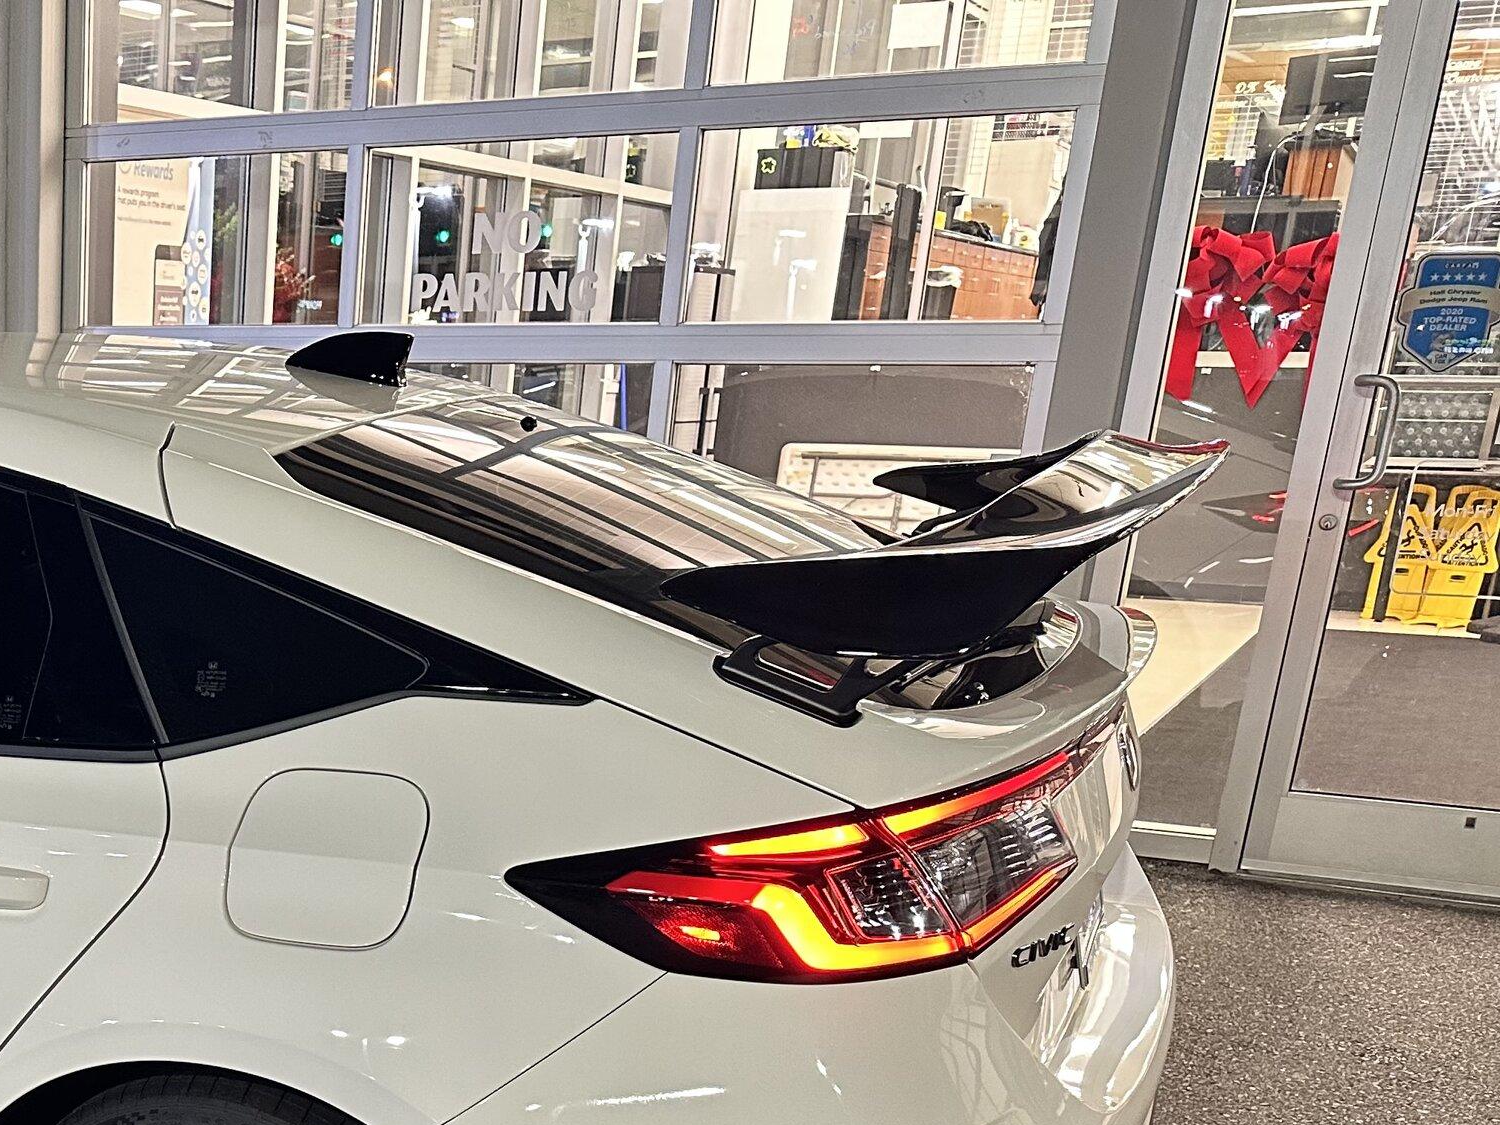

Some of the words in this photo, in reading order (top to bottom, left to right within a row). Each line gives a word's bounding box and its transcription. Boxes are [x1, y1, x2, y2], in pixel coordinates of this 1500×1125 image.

[133, 162, 174, 180] Rewards
[471, 211, 542, 254] NO
[411, 271, 599, 313] PARKING
[1423, 316, 1477, 325] TOP-RATED
[1429, 324, 1467, 332] DEALER
[1011, 922, 1075, 968] CIVIC
